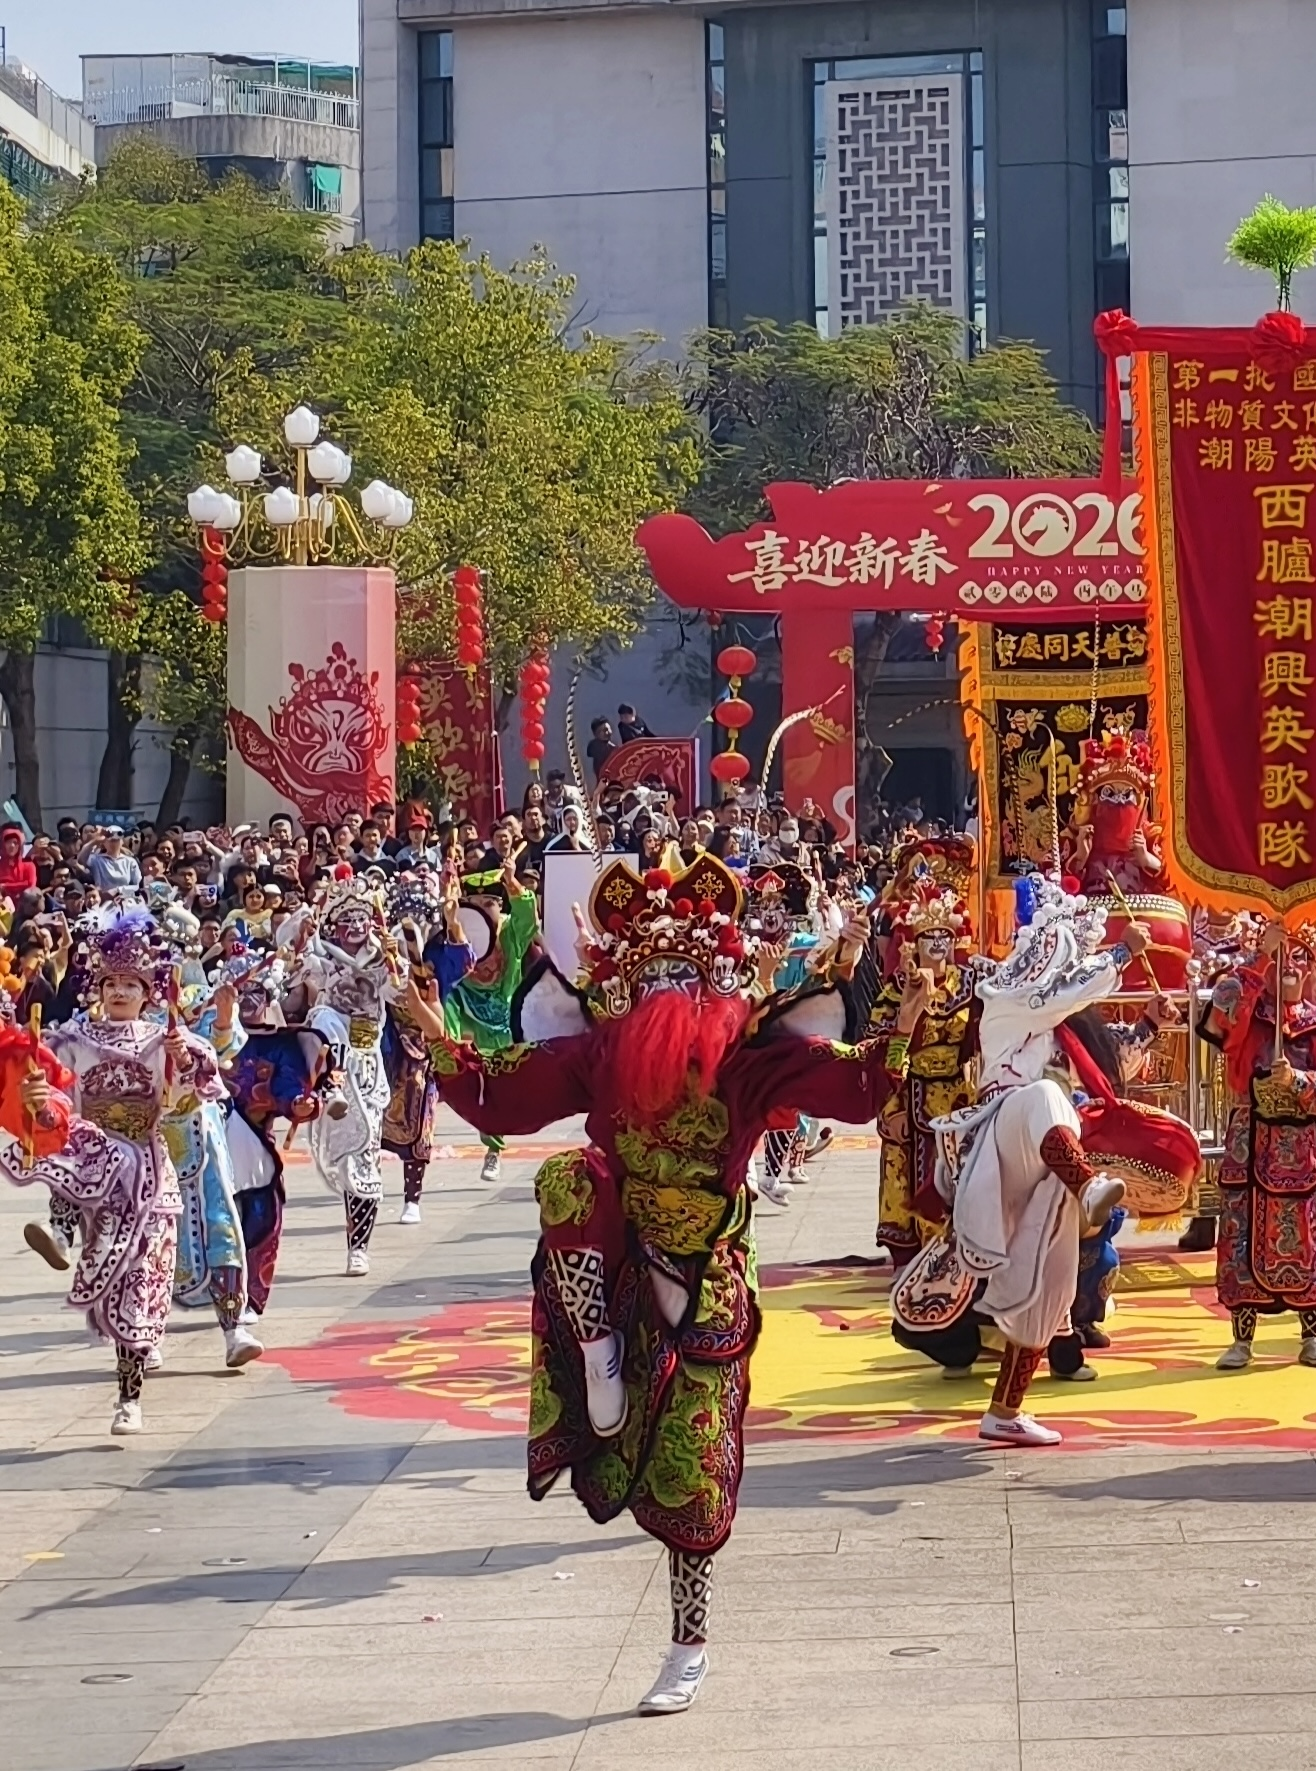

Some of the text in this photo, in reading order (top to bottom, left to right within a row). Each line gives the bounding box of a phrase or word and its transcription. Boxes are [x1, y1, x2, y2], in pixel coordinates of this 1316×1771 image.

[967, 492, 1147, 558] 2026
[727, 527, 959, 594] 喜迎新春
[987, 564, 1144, 577] HAPPY NEW YEAR
[1253, 483, 1316, 868] 西臚潮興英歌隊
